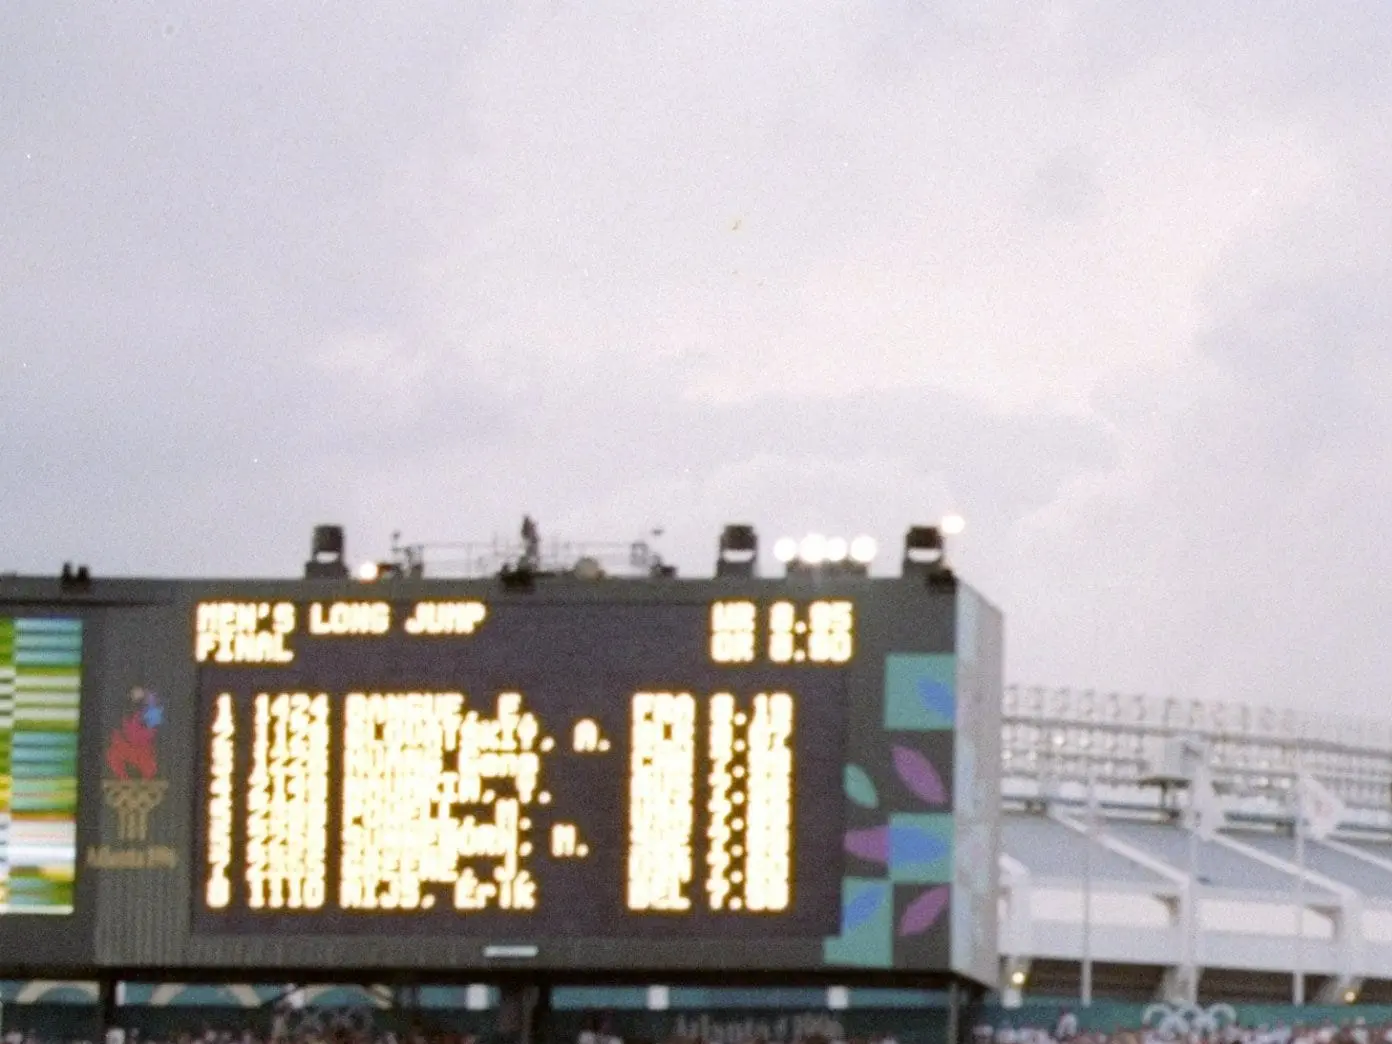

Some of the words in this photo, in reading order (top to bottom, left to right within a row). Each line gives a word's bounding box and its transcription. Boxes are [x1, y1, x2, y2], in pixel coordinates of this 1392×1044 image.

[197, 601, 295, 633] MEN'S
[310, 601, 391, 634] LONG
[405, 601, 487, 634] JUMP
[196, 632, 294, 663] FINAL
